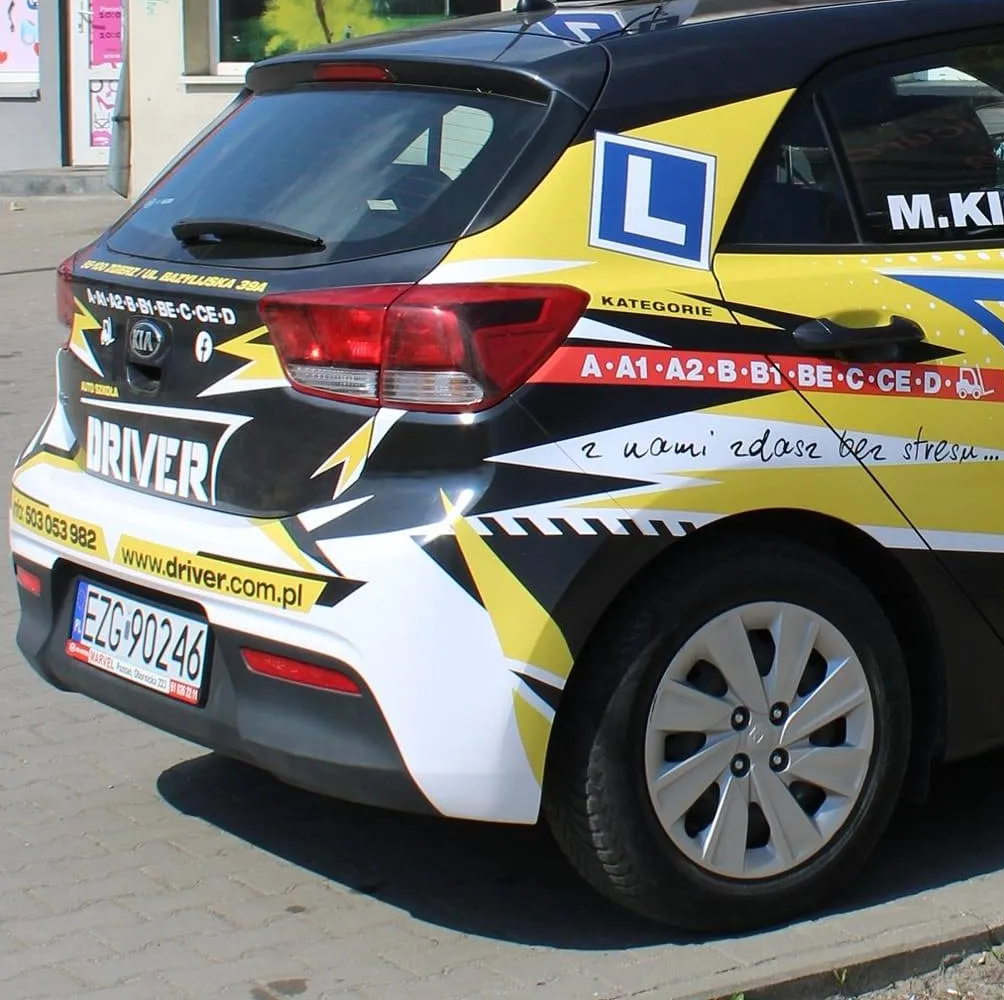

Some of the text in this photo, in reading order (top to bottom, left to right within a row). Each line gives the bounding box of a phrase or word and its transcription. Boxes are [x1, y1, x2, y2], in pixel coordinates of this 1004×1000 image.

[623, 153, 687, 246] L
[601, 295, 713, 318] KATEGORIE
[132, 327, 154, 353] KIA
[86, 415, 209, 503] DRIVER
[623, 430, 714, 459] nami
[730, 428, 820, 460] zdasz
[839, 428, 887, 462] bez
[25, 505, 43, 531] 503
[45, 514, 67, 541] 053
[70, 523, 97, 551] 982
[121, 546, 303, 610] www.driver.com.pl
[82, 590, 205, 681] EZG 90246
